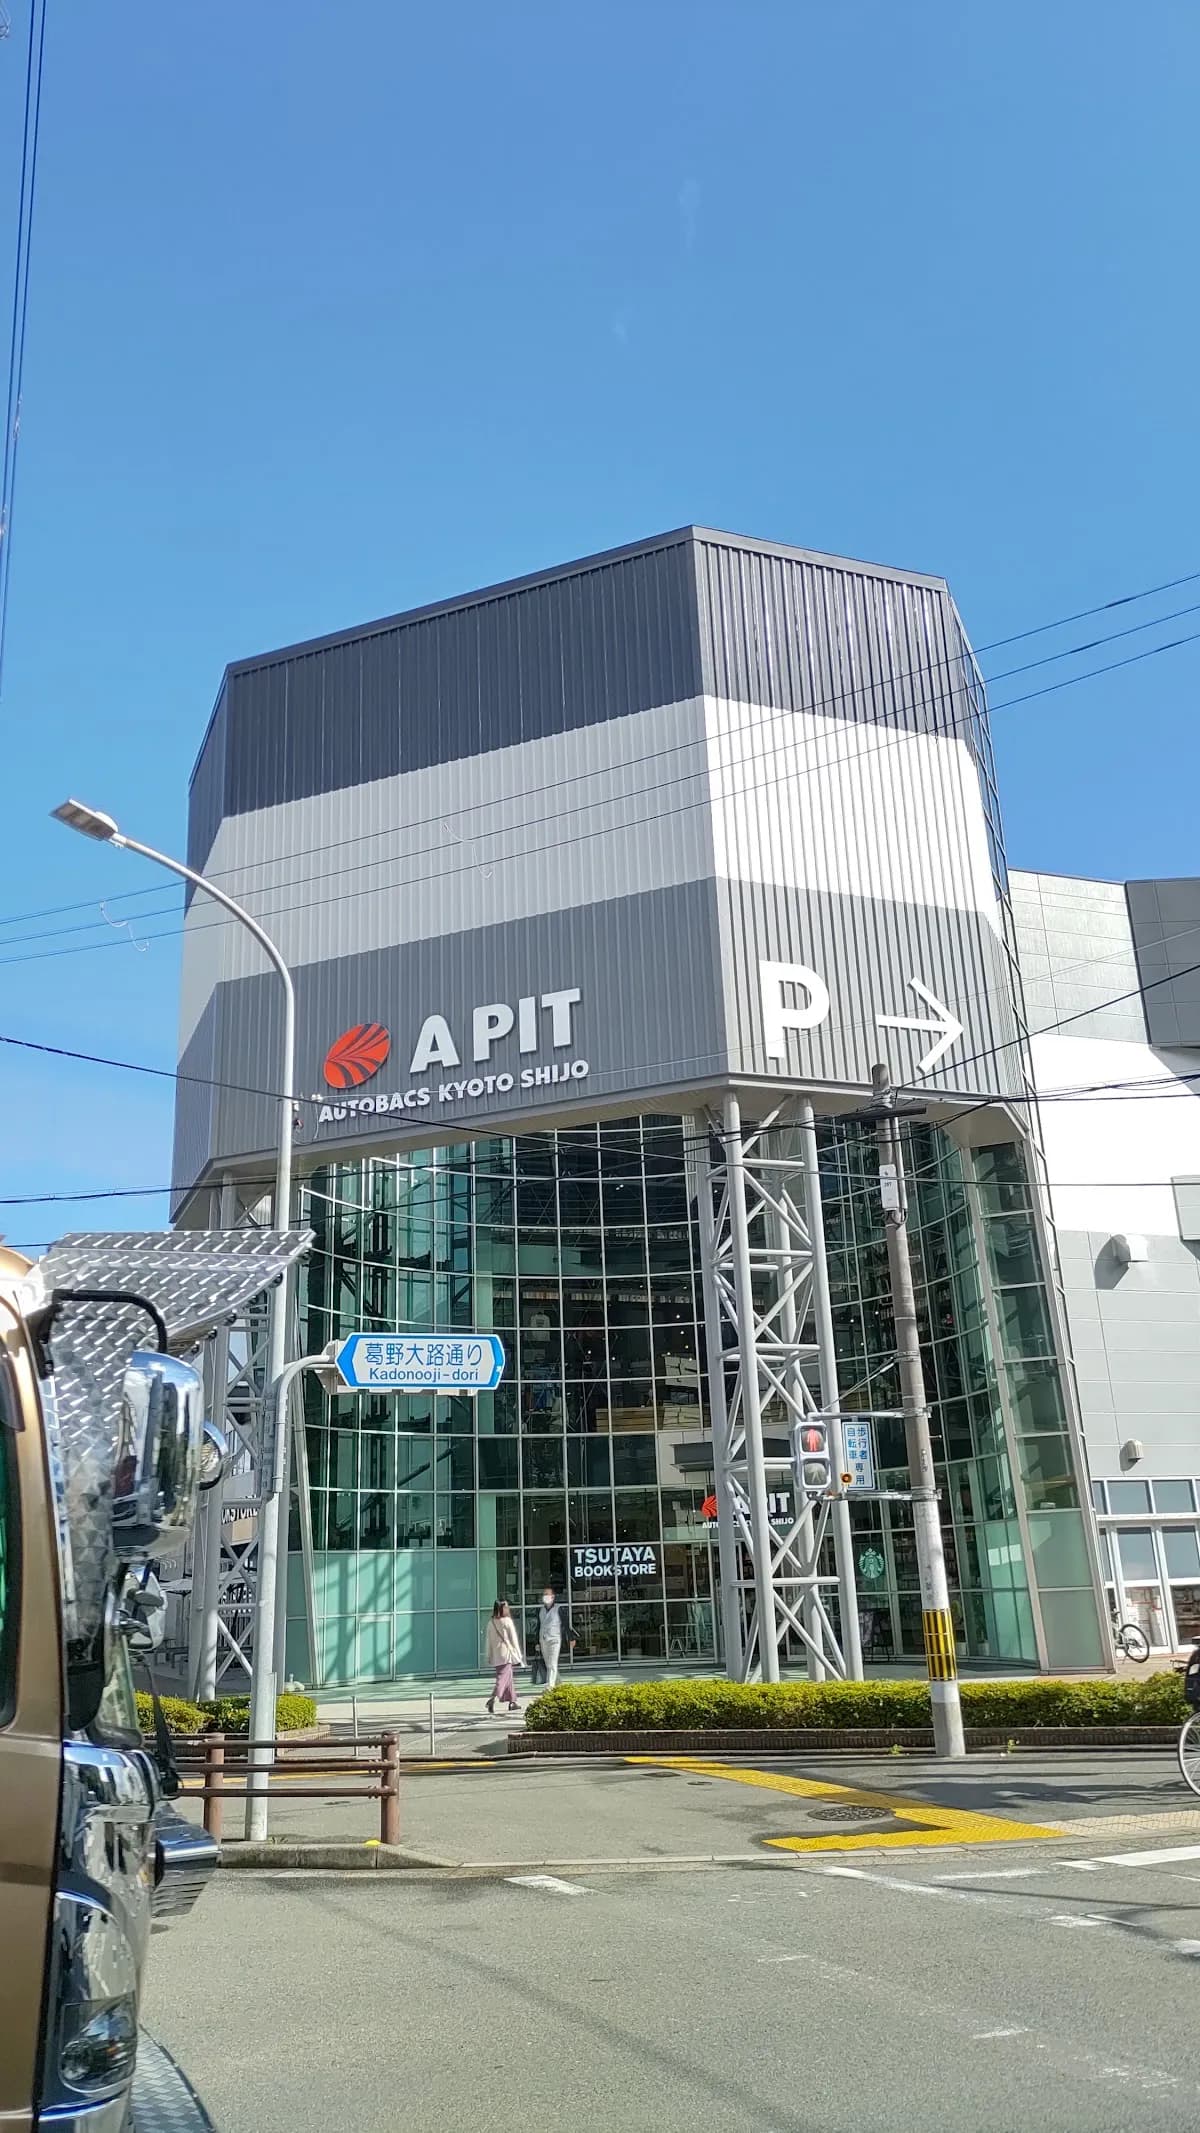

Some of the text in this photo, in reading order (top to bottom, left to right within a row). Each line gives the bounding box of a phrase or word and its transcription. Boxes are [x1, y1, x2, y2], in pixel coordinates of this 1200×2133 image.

[759, 960, 829, 1058] P
[319, 1059, 589, 1123] AUTOBACS KYOTO SHIJO
[365, 1343, 482, 1366] 葛野大路通り
[369, 1367, 478, 1383] Kadonooji-dori
[770, 1517, 794, 1526] SHIJO
[574, 1546, 656, 1564] TSUTAYA
[574, 1563, 656, 1577] BOOKSTORE
